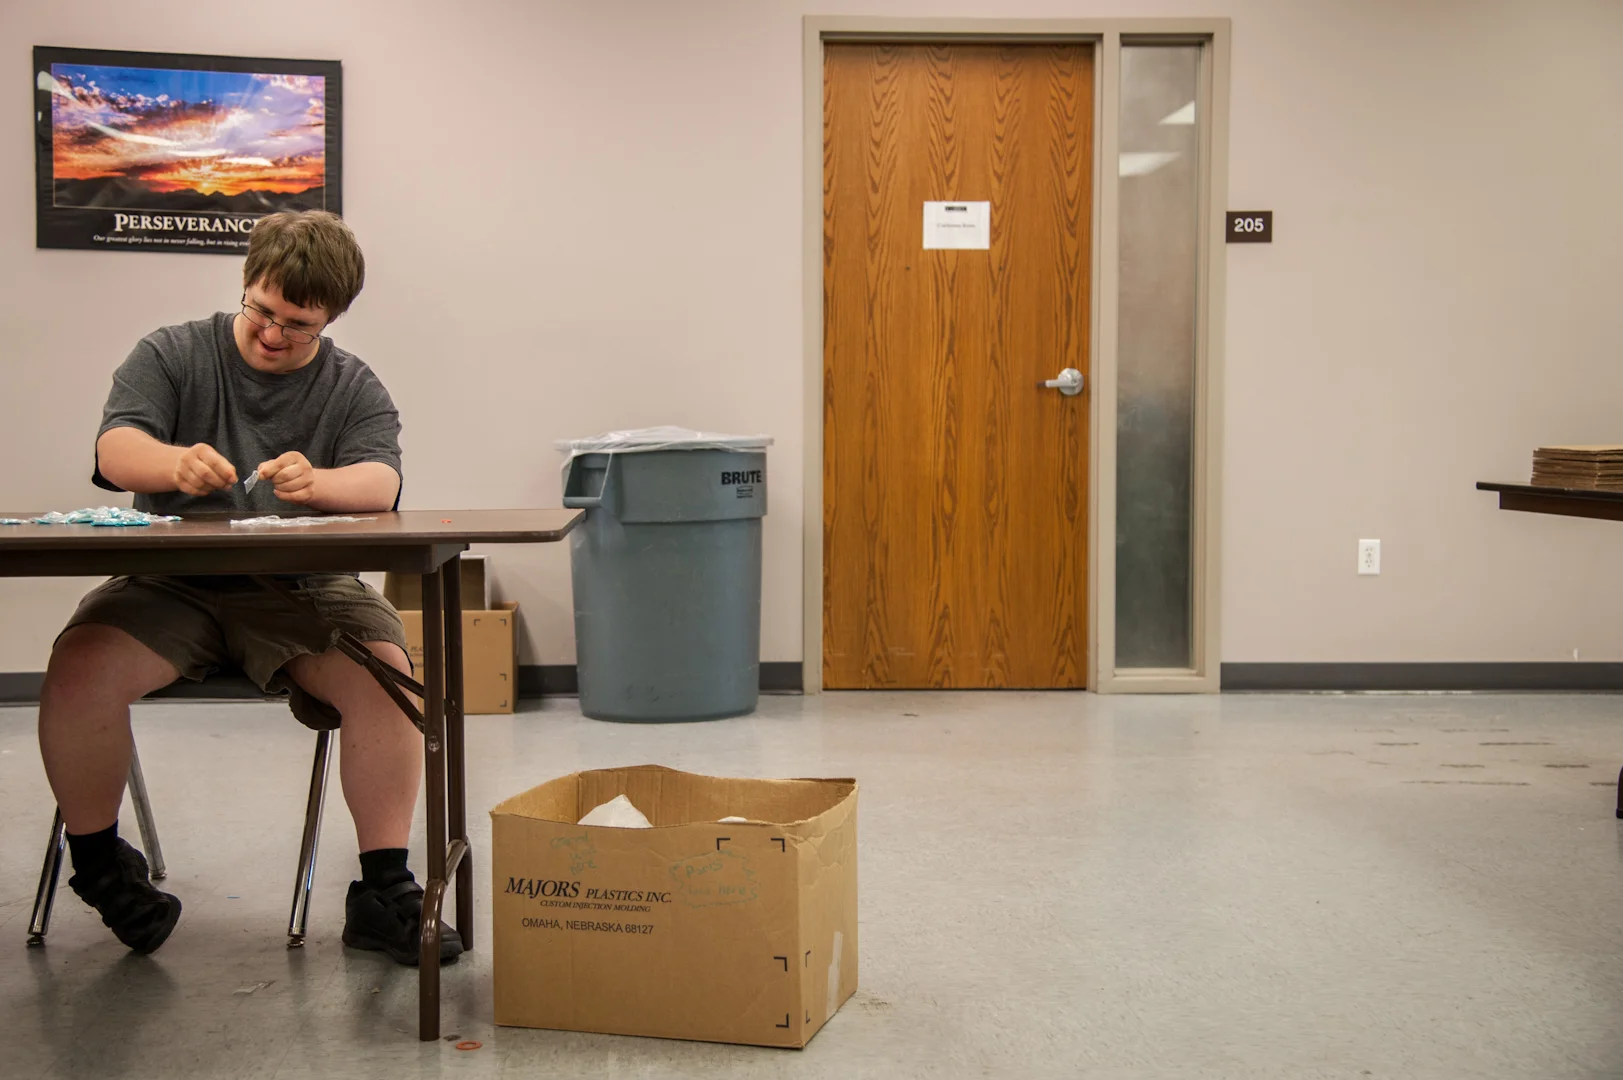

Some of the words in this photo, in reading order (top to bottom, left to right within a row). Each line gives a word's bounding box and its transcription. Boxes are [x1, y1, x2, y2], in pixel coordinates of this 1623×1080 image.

[1234, 217, 1264, 233] 205
[106, 235, 127, 243] greatest
[128, 235, 142, 244] glory
[721, 470, 762, 485] BRUTE
[504, 877, 581, 899] MAJORS
[585, 888, 642, 902] PLASTICS
[645, 891, 672, 903] INC.
[540, 899, 572, 908] CUSTOM
[572, 901, 611, 911] INJECTION
[613, 904, 651, 913] MOLDING
[521, 917, 563, 931] OMAHA,
[566, 920, 624, 933] NEBRASKA
[625, 924, 654, 935] 68127
